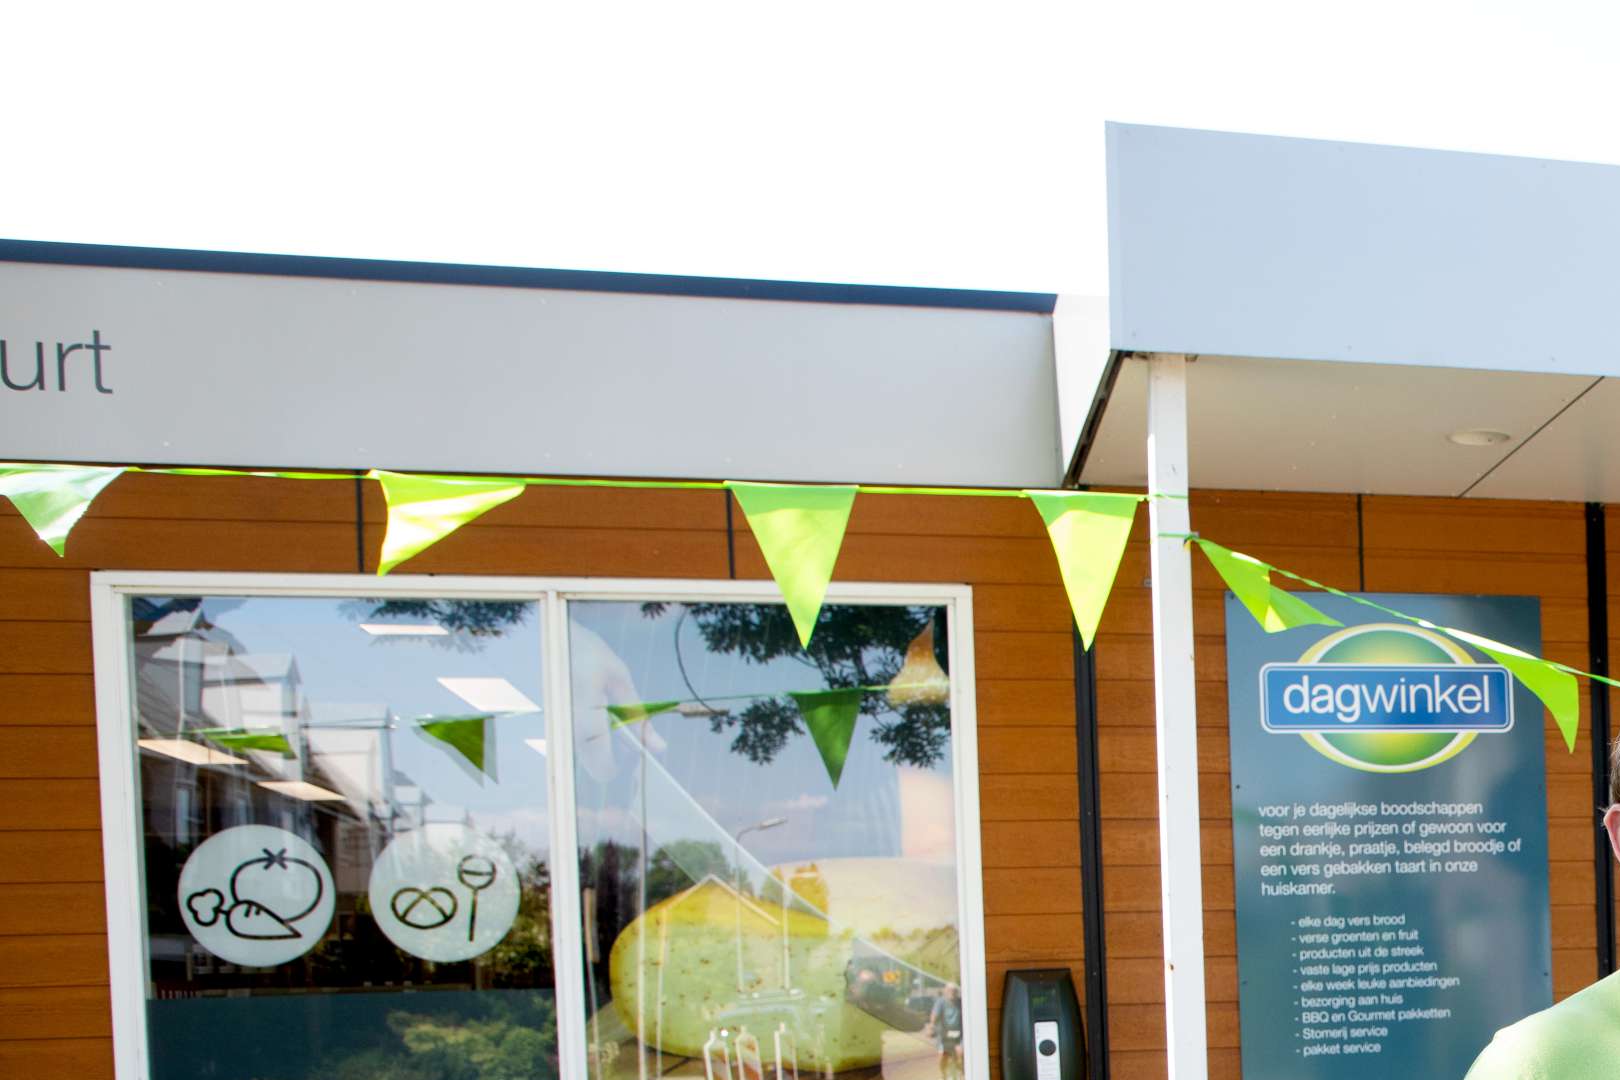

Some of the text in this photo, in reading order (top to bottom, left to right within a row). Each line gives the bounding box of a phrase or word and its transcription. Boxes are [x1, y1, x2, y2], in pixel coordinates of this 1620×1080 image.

[1283, 674, 1489, 722] dagwinkel
[1259, 801, 1483, 819] voor je dagelijkse boodschappen
[1260, 821, 1506, 839] tegen eerlijke prijzen of gewoon voor
[1260, 838, 1521, 858] een drankje, praatje, belegd broodje of
[1261, 860, 1477, 877] een vers gebakken taart in onze
[1261, 881, 1335, 896] huiskamer.
[1299, 914, 1405, 928] elke dag vers brood
[1299, 930, 1418, 945] verse groenten en fruit
[1300, 945, 1424, 961] producten uit de streek
[1301, 961, 1437, 976] vaste lage prijs producten
[1301, 976, 1460, 991] elke week leuke aanbiedingen
[1302, 994, 1403, 1009] bezorging aan huis
[1303, 1008, 1450, 1023] BBQ en Gourmet pakketten
[1350, 1026, 1388, 1037] service
[1303, 1042, 1381, 1057] pakket service
